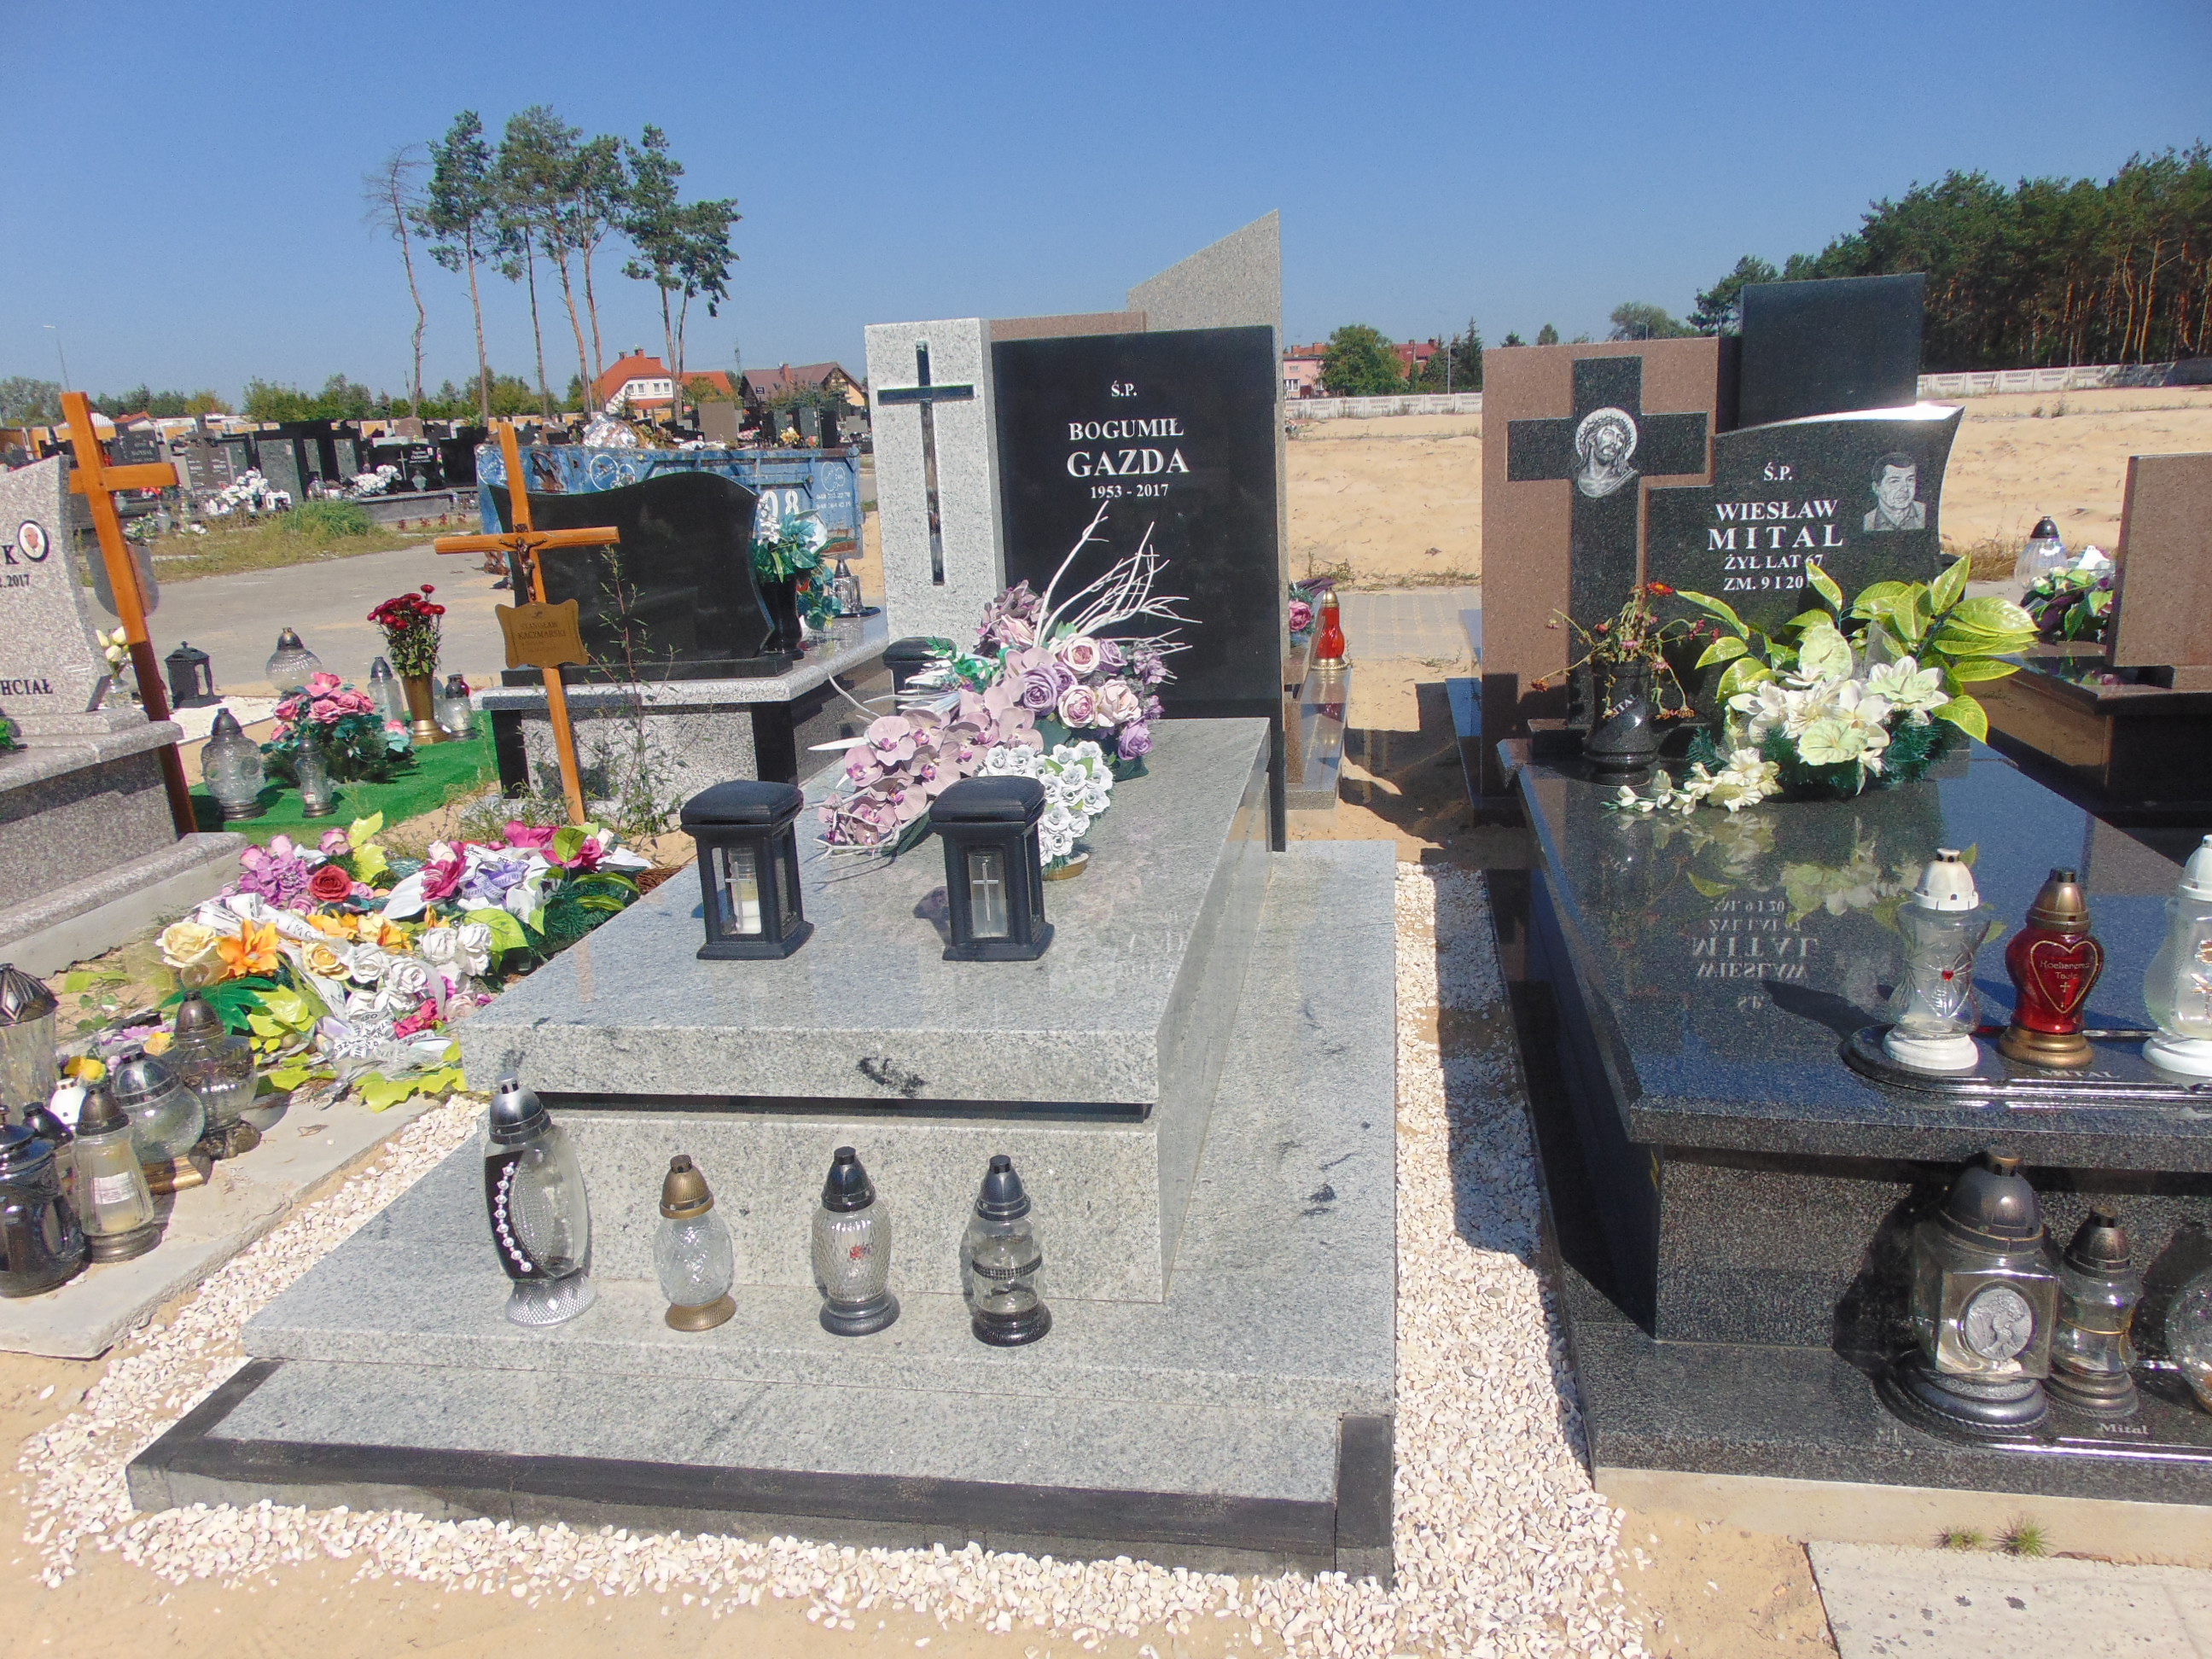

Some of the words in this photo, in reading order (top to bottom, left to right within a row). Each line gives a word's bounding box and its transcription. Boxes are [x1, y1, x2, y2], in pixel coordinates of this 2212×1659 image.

[1111, 380, 1138, 397] Ś.P.
[1068, 417, 1185, 440] BOGUMIŁ
[1067, 448, 1190, 478] GAZDA
[1763, 462, 1792, 481] Ś.P.
[1091, 486, 1122, 498] 1953
[1137, 484, 1169, 498] 2017
[1715, 499, 1838, 521] WIESŁAW
[1707, 524, 1842, 550] MITAL
[1724, 554, 1761, 570] ŻYŁ
[1766, 555, 1802, 569] LAT
[1724, 577, 1756, 591] ZM.
[1761, 576, 1770, 590] 9
[2099, 1423, 2150, 1435] Mital
